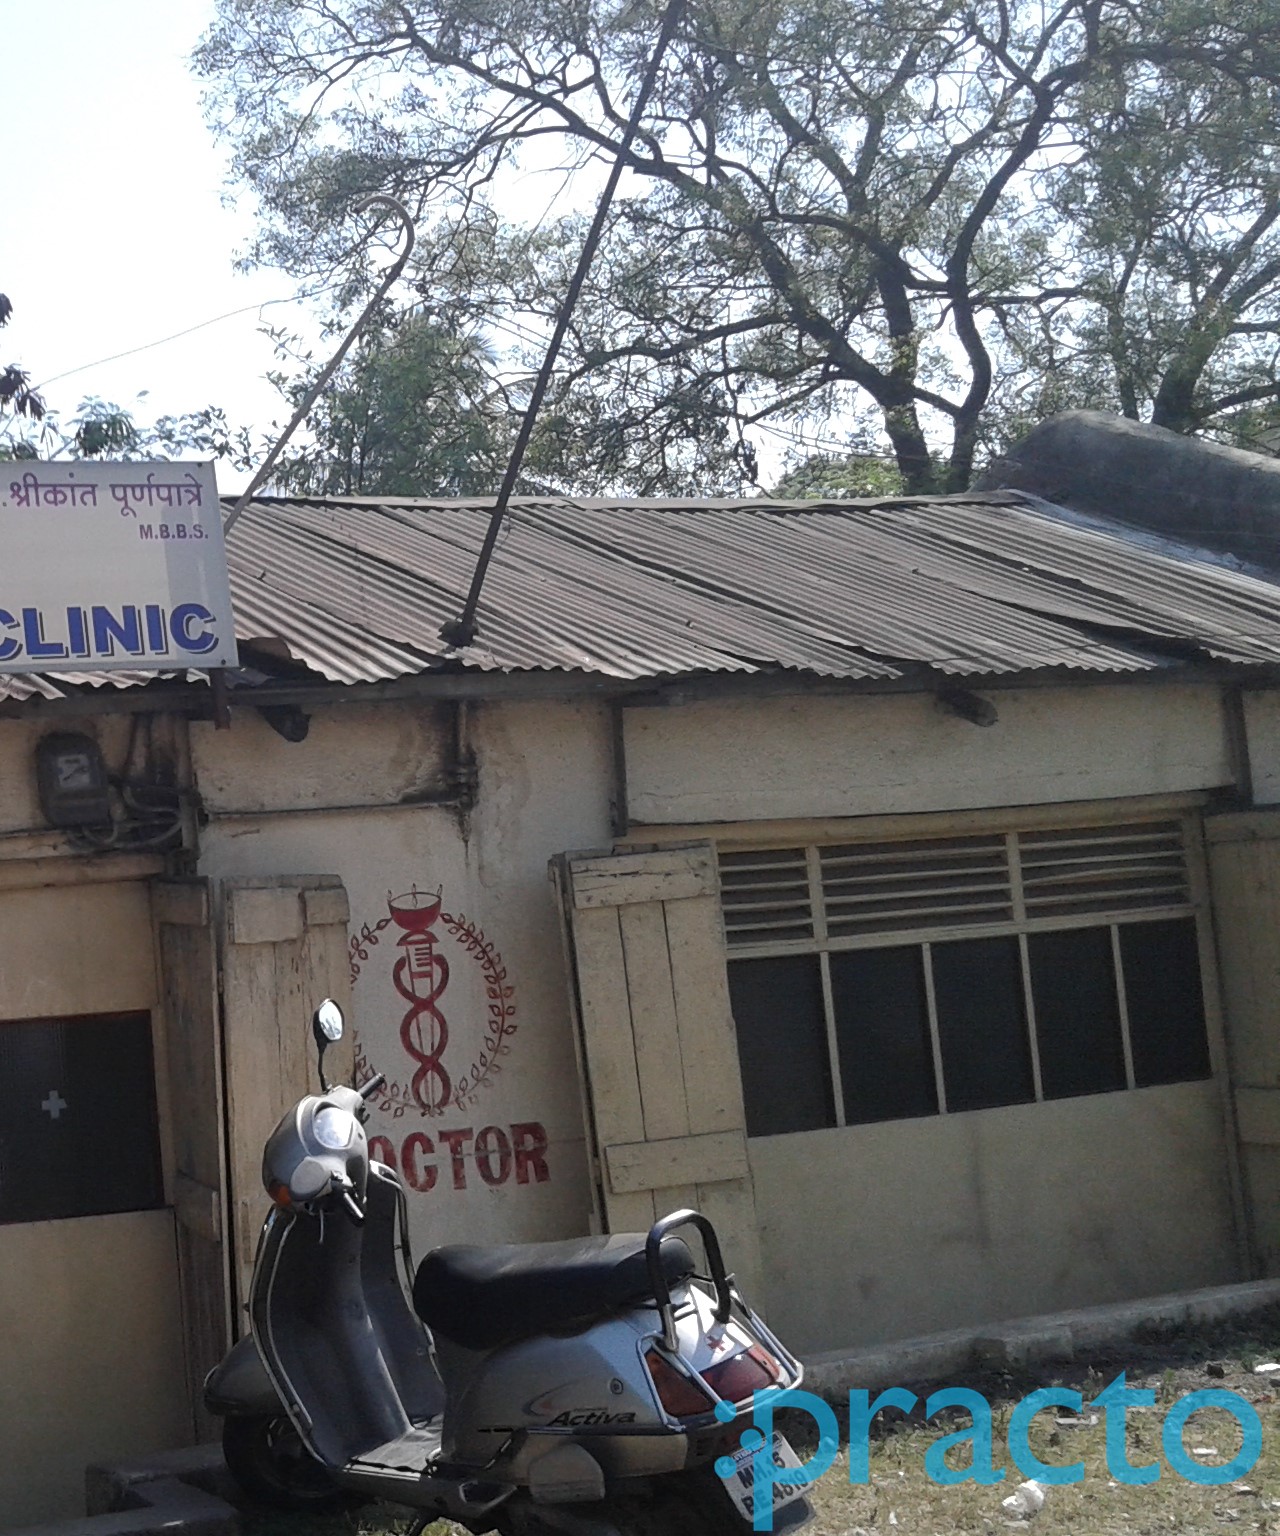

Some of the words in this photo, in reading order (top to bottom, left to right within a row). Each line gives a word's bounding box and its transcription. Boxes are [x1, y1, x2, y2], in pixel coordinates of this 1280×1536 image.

[109, 473, 203, 518] पूर्णपात्रे
[139, 524, 209, 540] M.B.B.S.
[368, 1121, 551, 1193] OCTOR
[546, 1410, 636, 1426] Activa
